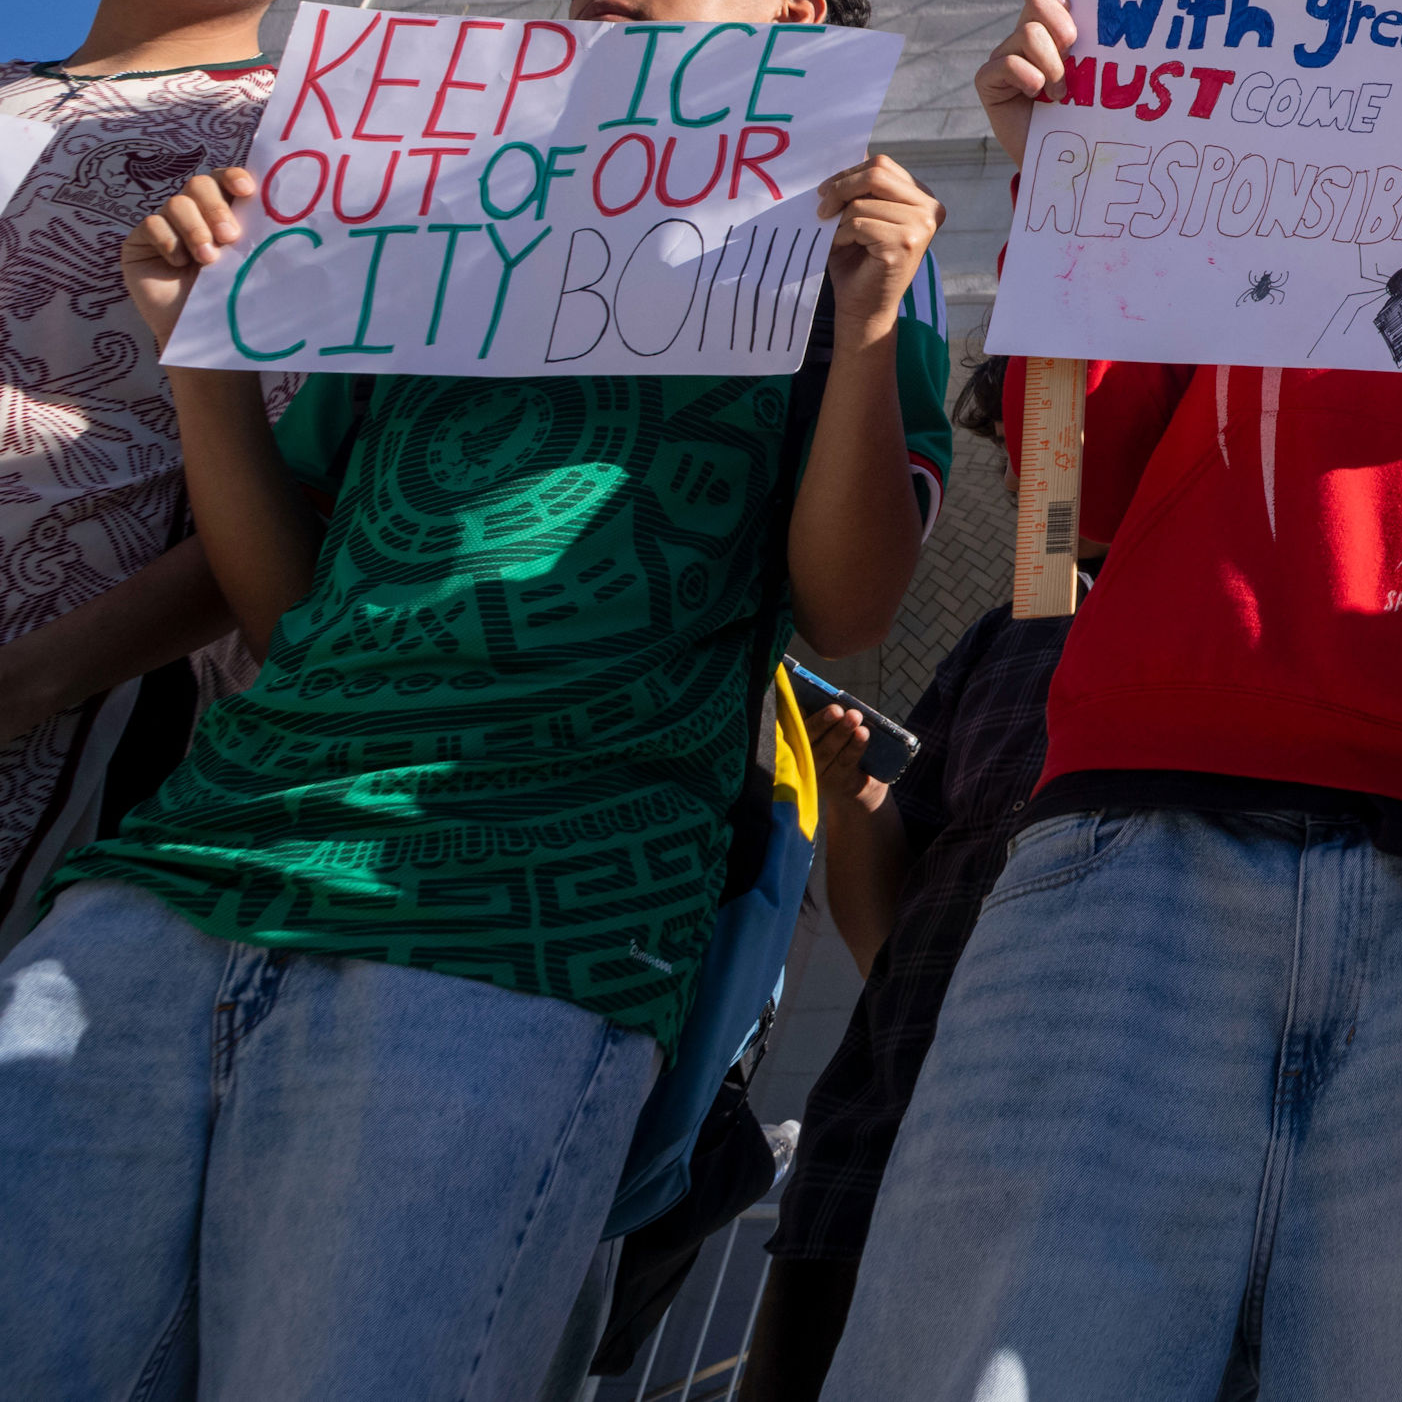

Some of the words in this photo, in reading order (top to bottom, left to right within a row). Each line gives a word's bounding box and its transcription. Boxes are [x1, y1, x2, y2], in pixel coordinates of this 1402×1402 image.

[280, 9, 578, 143] KEEP
[598, 23, 827, 131] ICE
[1034, 55, 1235, 121] MUST
[1232, 71, 1392, 132] COME
[262, 147, 471, 224] OUT
[479, 139, 588, 221] OF
[592, 126, 792, 216] OUR
[227, 223, 554, 361] CITY
